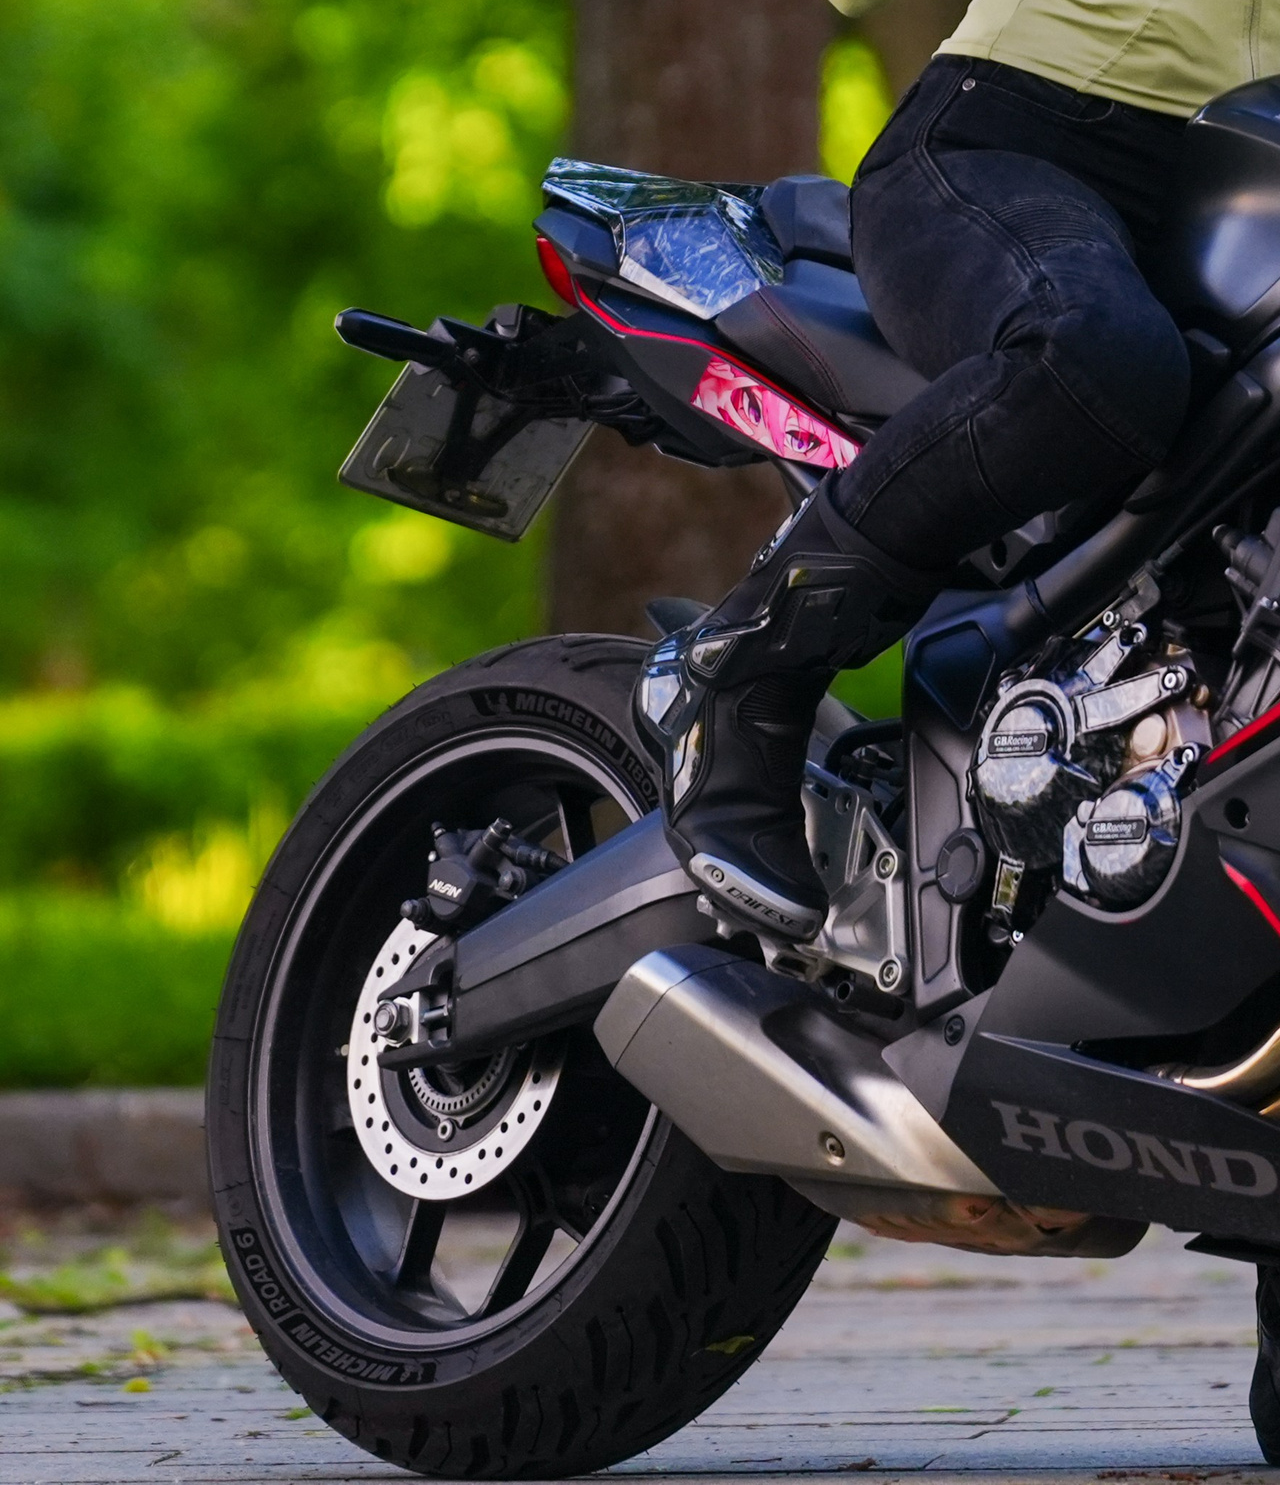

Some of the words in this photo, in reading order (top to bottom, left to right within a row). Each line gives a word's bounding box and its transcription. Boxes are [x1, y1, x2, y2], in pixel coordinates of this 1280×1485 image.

[514, 692, 618, 750] MICHELIN
[429, 878, 462, 898] NISSIN
[726, 886, 801, 930] DAINESE
[245, 1255, 291, 1314] ROAD
[290, 1322, 399, 1382] MICHELIN
